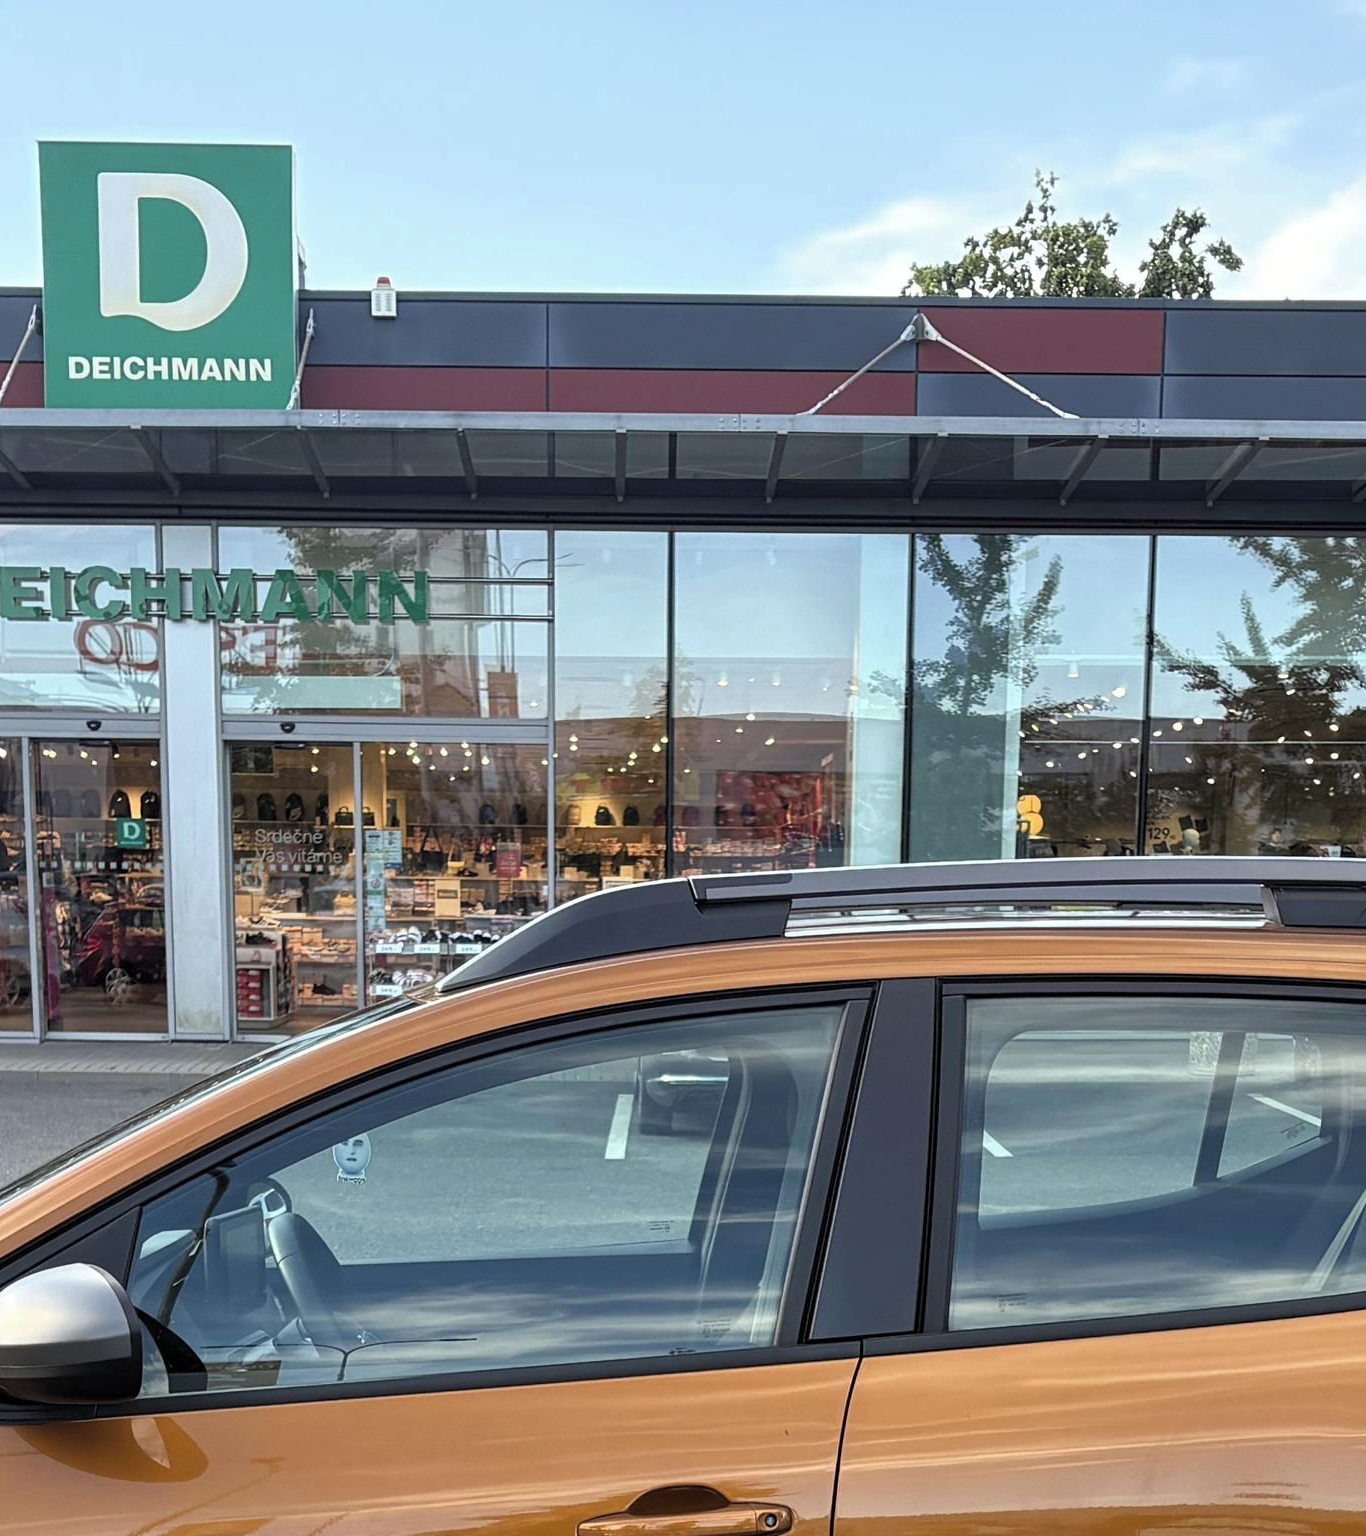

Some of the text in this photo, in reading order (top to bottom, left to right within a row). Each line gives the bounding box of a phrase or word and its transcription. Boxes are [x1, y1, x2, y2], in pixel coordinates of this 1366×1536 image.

[97, 172, 248, 331] D
[68, 356, 272, 381] DEICHMANN
[123, 822, 141, 839] D
[254, 828, 324, 844] Srdečně
[1147, 827, 1171, 839] 129
[255, 848, 343, 865] Vás vítáme
